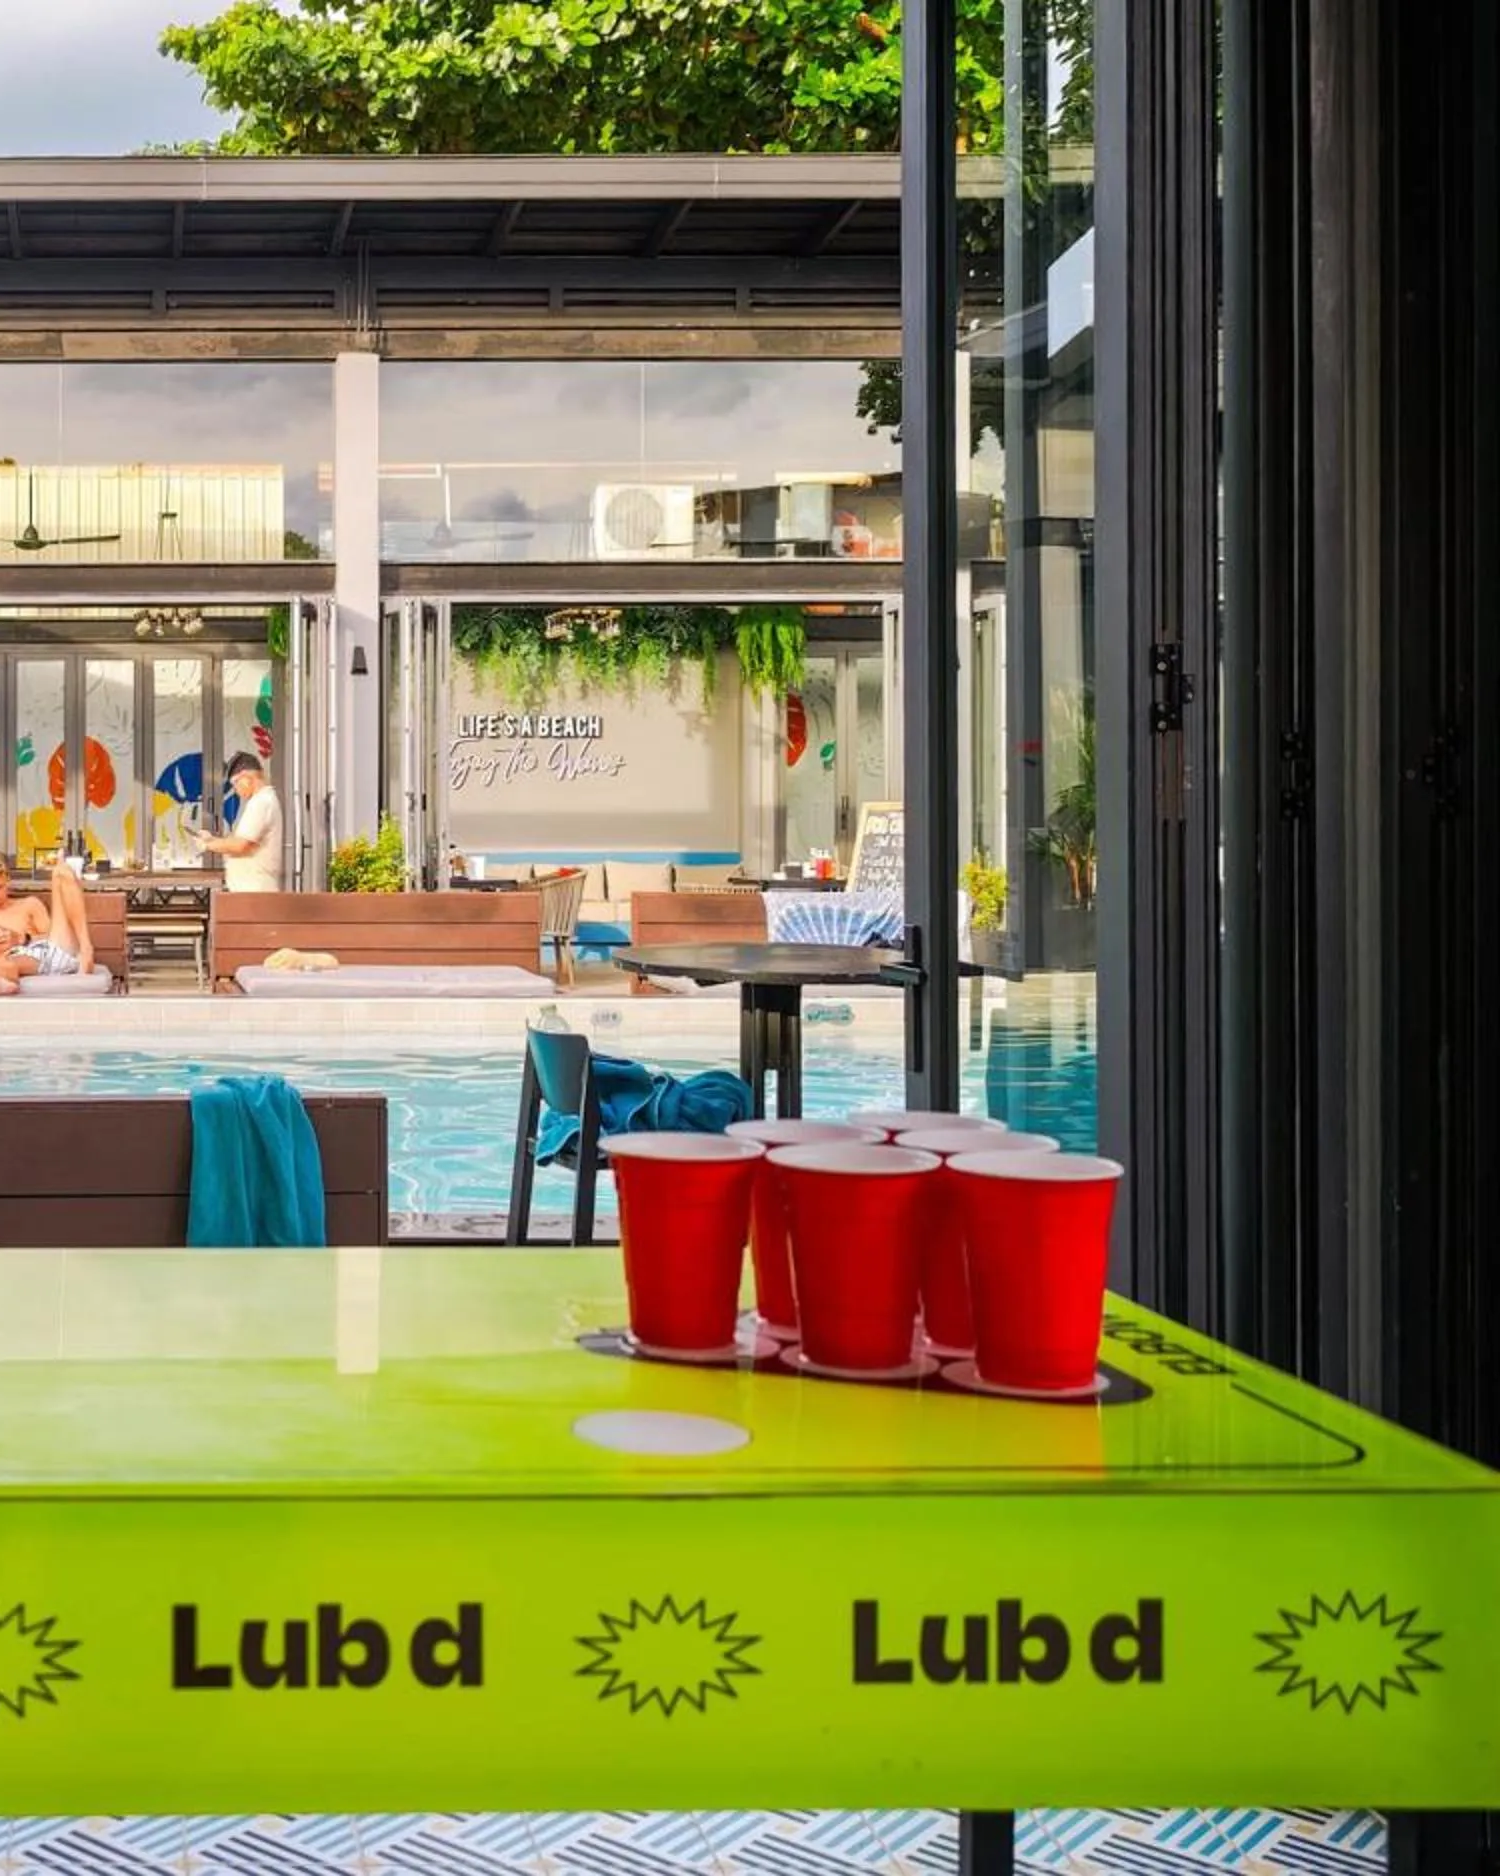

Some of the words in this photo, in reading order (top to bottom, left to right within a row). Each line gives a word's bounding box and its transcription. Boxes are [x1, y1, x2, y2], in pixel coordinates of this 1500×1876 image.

[458, 715, 516, 737] LIFE'S
[521, 715, 534, 737] A
[538, 715, 602, 738] BEACH
